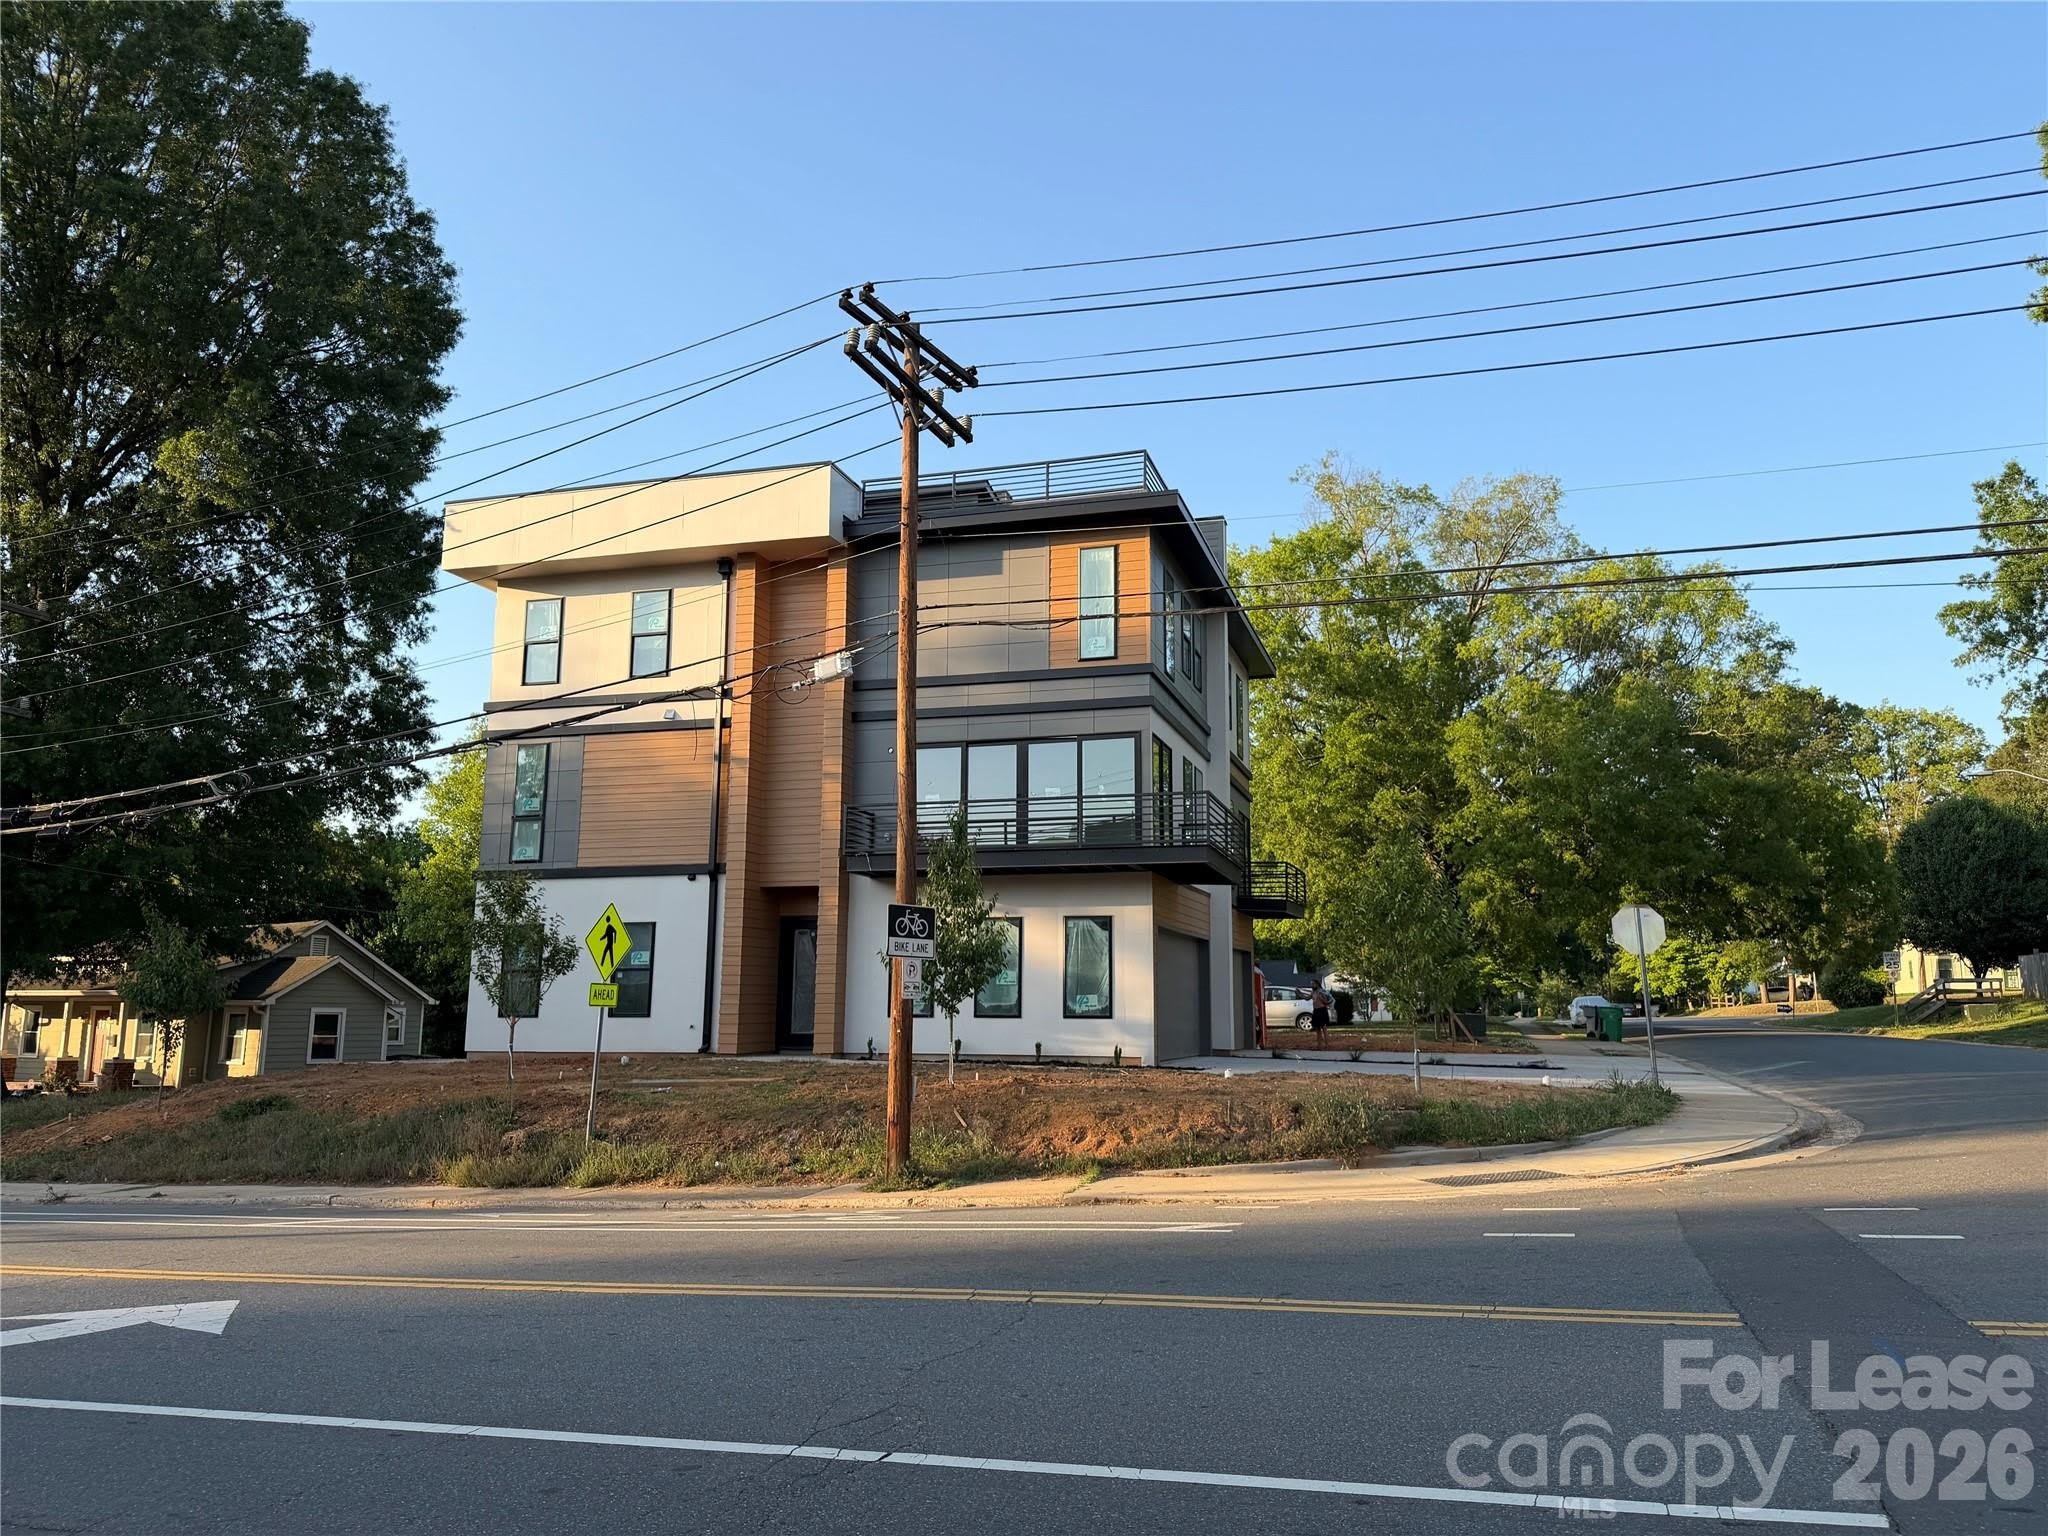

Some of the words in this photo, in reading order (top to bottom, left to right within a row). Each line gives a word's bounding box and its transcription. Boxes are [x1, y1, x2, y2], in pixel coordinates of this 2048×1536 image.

[894, 941, 909, 952] BIKE
[912, 943, 929, 954] LANE
[1886, 961, 1900, 969] 25
[592, 989, 615, 1000] AHEAD
